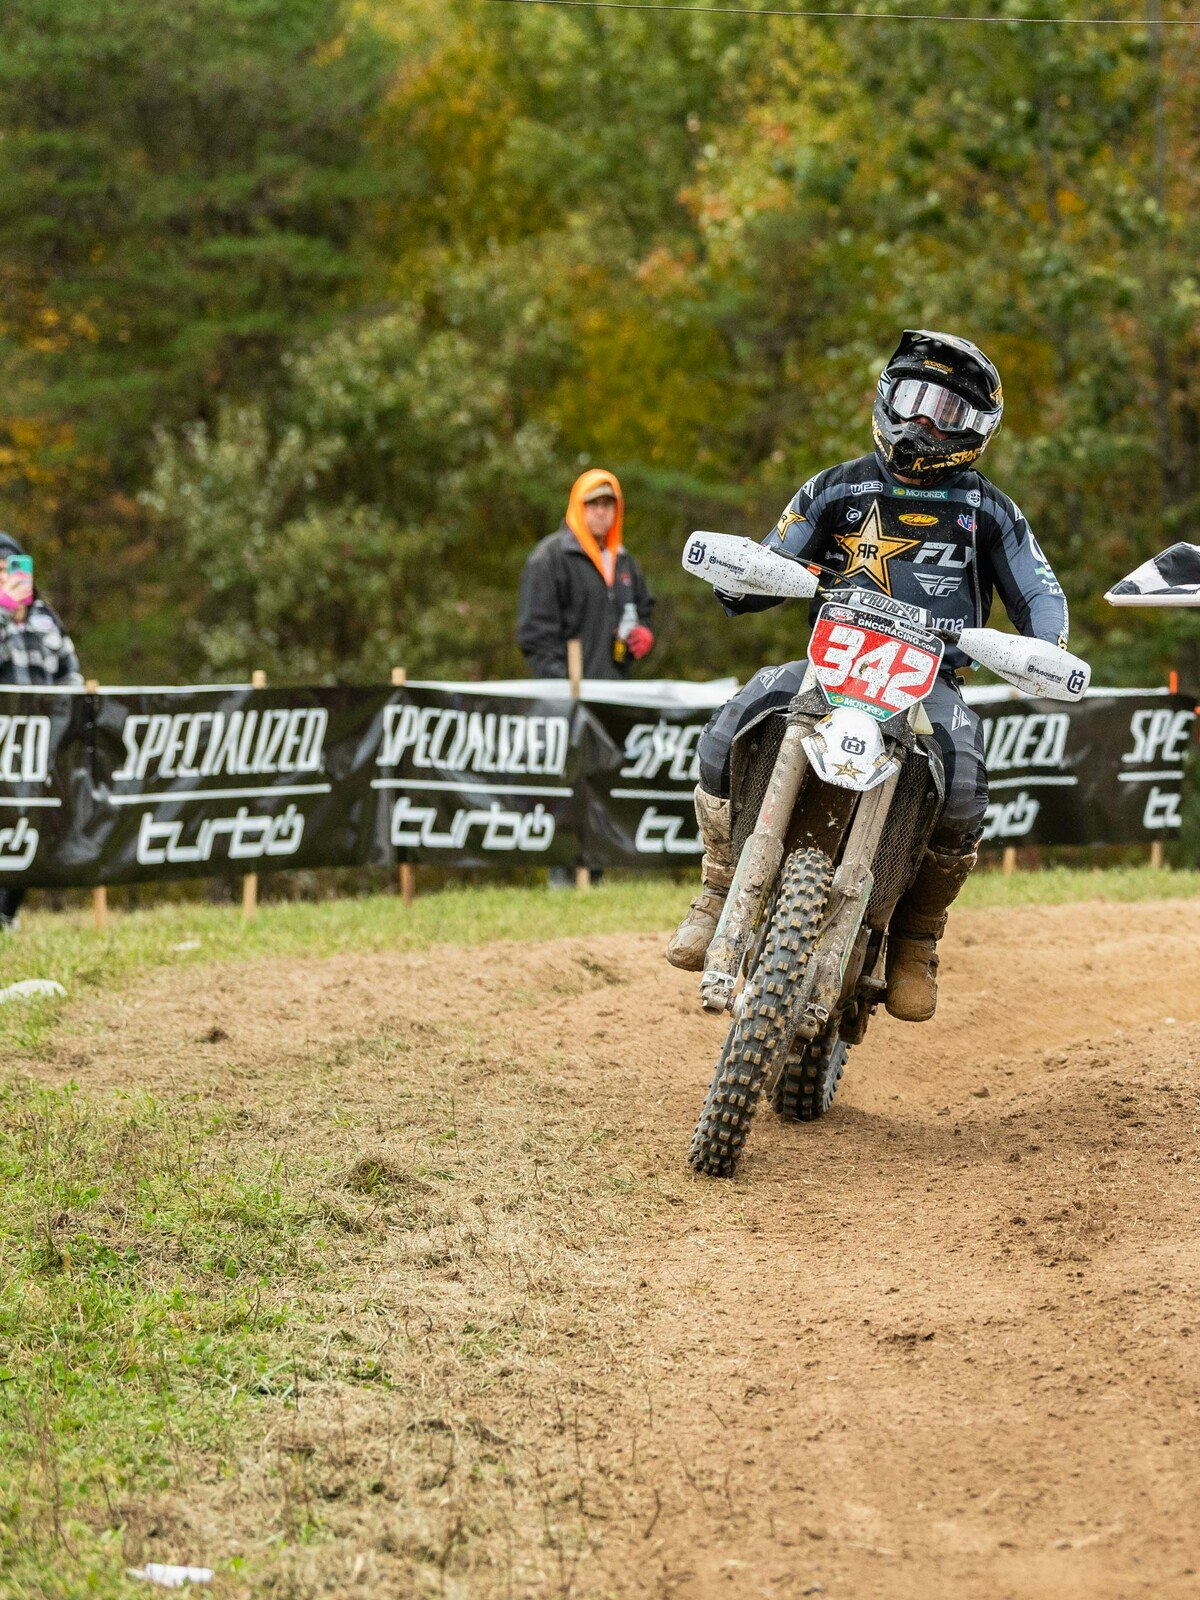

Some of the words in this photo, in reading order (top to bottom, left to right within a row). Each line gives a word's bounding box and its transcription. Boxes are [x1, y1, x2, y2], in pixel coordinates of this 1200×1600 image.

[905, 489, 946, 499] MOTOREX
[858, 618, 937, 653] GNCCRACING.COM
[814, 625, 934, 711] 342
[844, 697, 886, 719] MOTOREX
[112, 707, 328, 781] SPECIALIZED
[375, 704, 569, 777] SPECIALIZED
[137, 804, 304, 865] turbo
[391, 797, 555, 851] turbo
